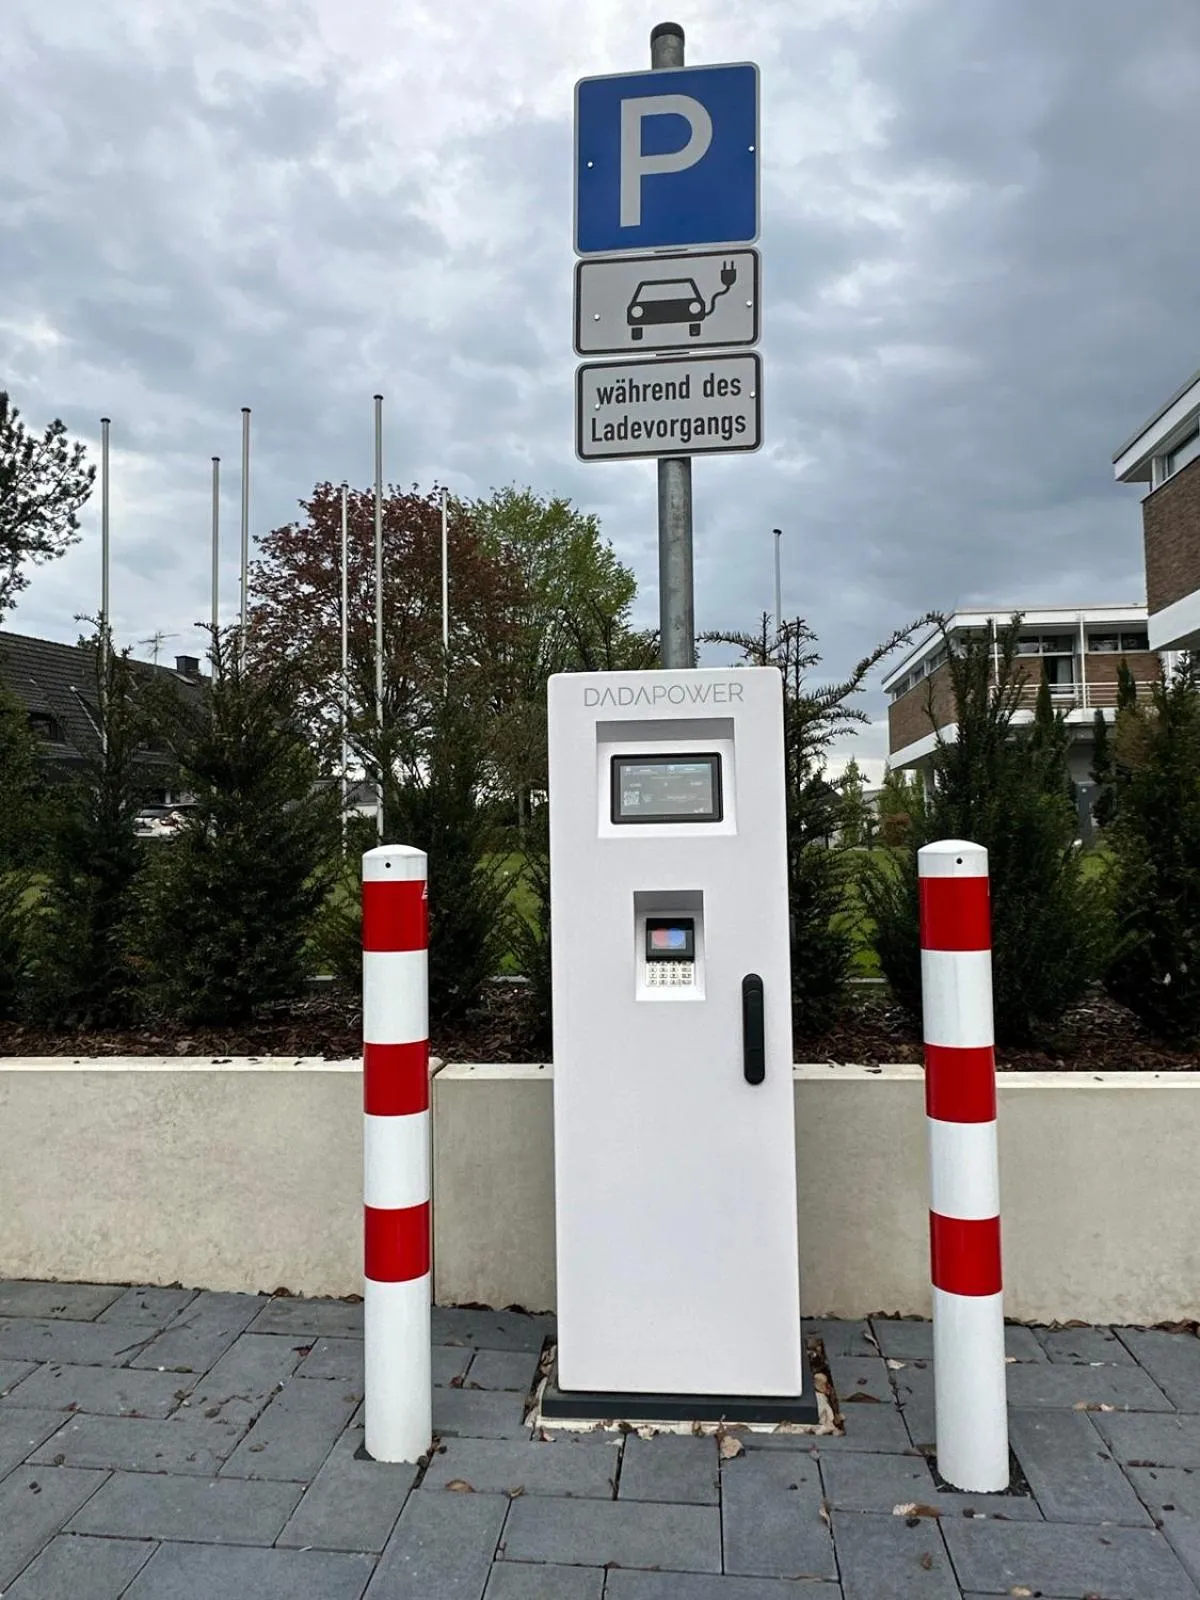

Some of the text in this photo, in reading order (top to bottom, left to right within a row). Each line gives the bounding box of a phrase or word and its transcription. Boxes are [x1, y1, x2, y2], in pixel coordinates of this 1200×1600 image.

[620, 94, 713, 228] P
[596, 372, 742, 405] während des
[591, 414, 747, 443] Ladevorgangs
[584, 683, 744, 707] DADAPOWER
